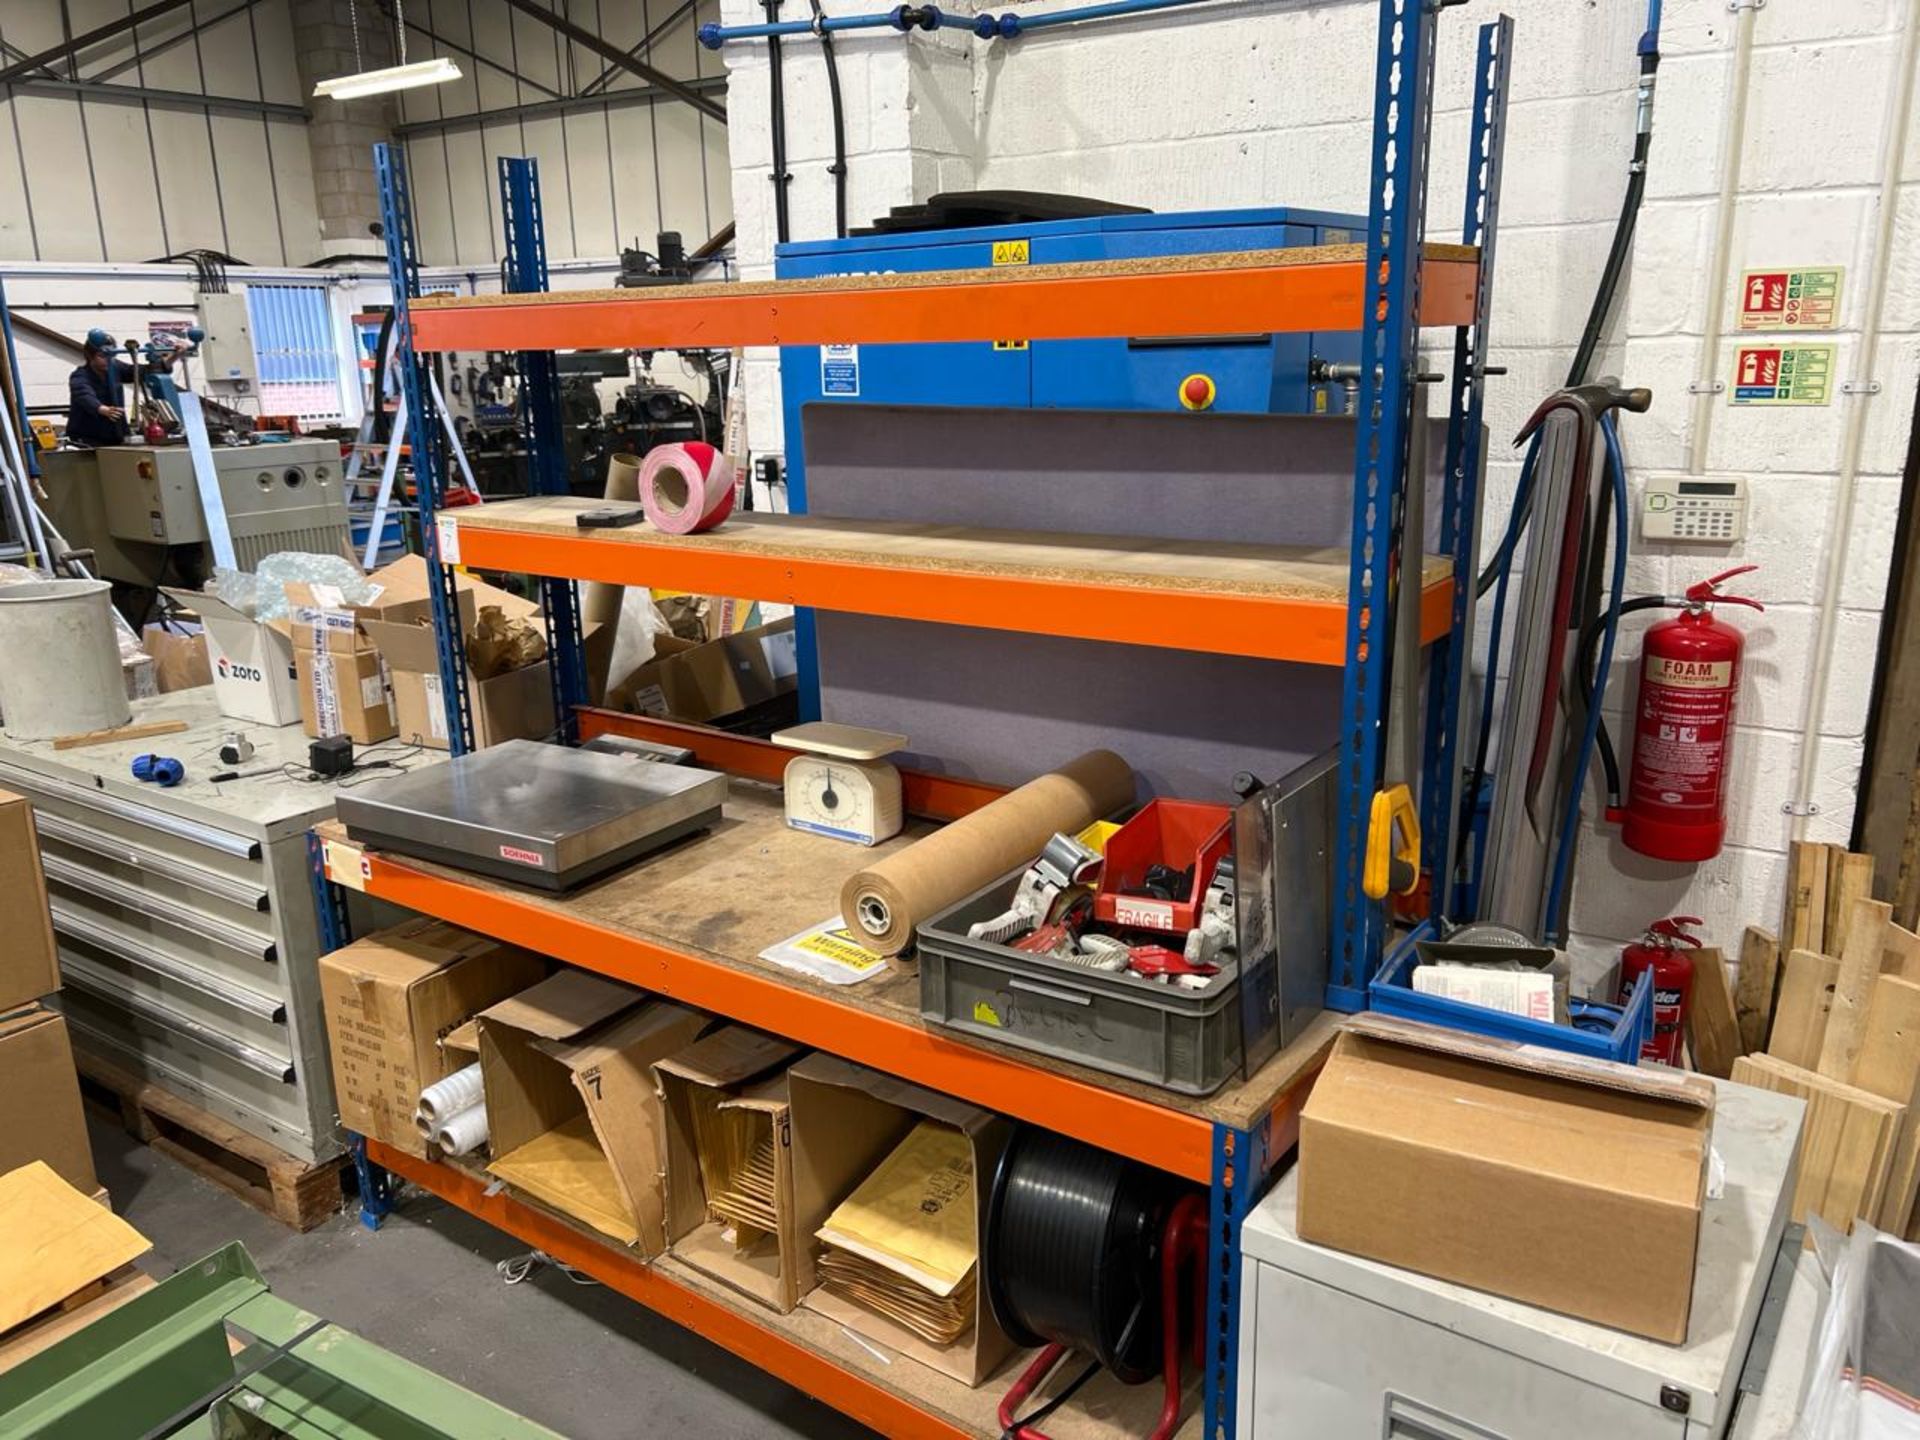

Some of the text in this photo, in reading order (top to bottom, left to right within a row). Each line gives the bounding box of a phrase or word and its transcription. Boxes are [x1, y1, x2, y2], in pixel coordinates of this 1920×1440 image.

[231, 665, 261, 682] zoro
[1664, 661, 1713, 676] FOAM
[1117, 908, 1172, 929] FRAGILE
[580, 1065, 601, 1080] SIZE
[587, 1075, 602, 1100] 7
